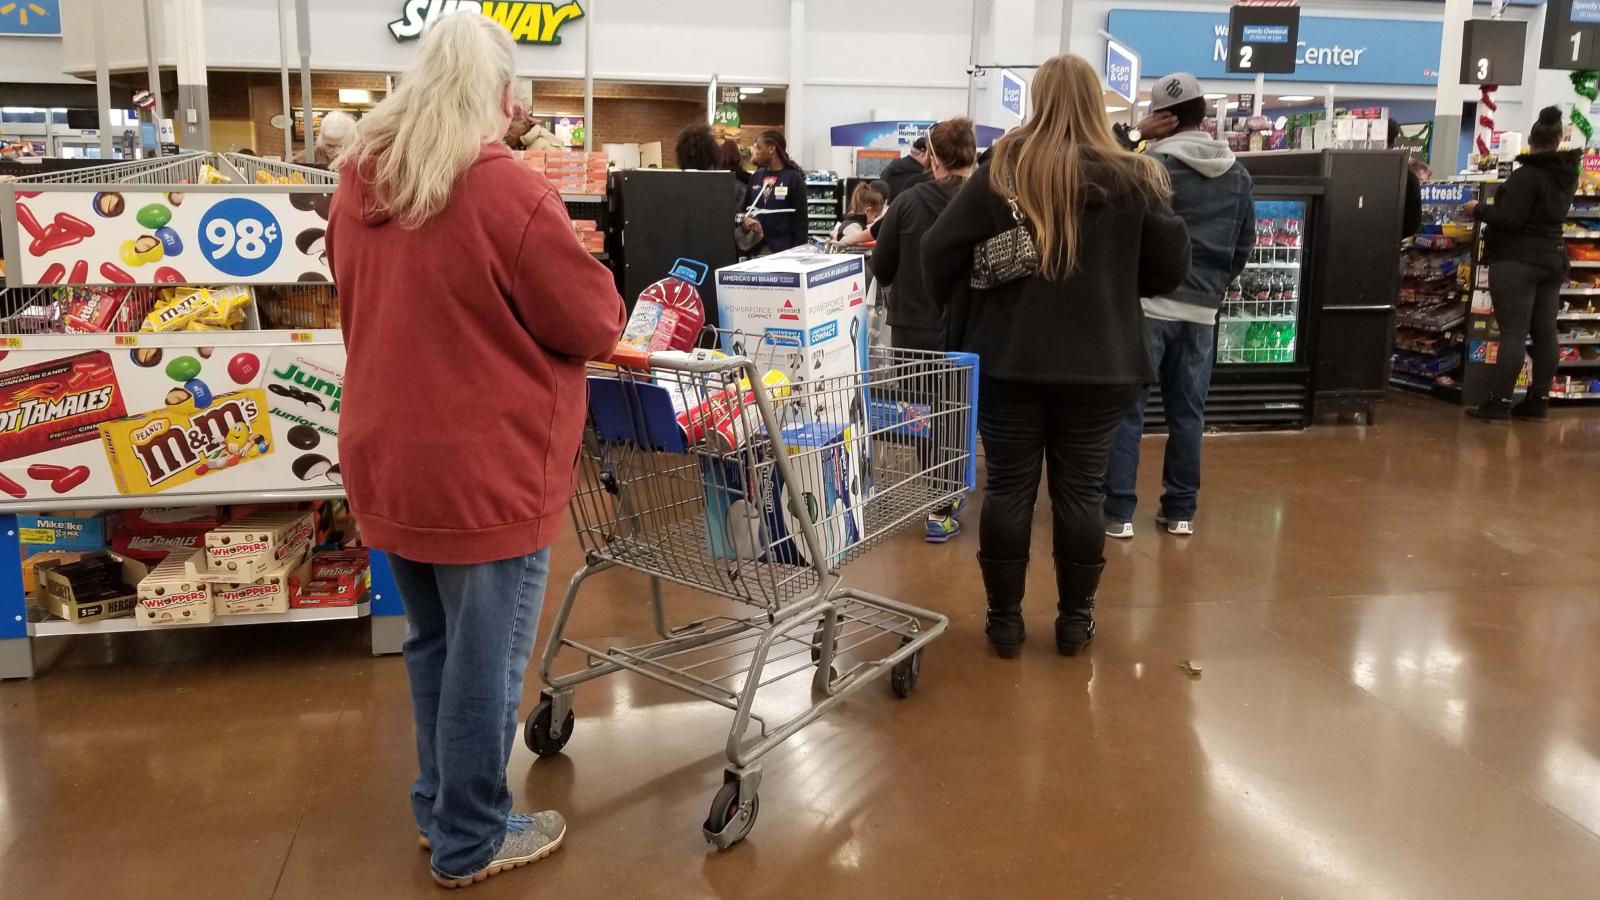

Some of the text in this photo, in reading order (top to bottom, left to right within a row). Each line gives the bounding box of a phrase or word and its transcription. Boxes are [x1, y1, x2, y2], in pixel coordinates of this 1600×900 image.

[387, 0, 584, 43] SWAY
[1571, 31, 1582, 62] 1
[1239, 45, 1253, 68] 2
[1110, 64, 1130, 74] Scan
[1477, 58, 1487, 80] 3
[1004, 87, 1020, 96] Scan
[1431, 187, 1463, 200] treats
[205, 218, 278, 260] 98¢
[722, 275, 751, 283] AMERICA'S
[758, 276, 778, 284] BRAND
[810, 270, 832, 284] AMERICA'S
[835, 265, 849, 276] BRAND
[725, 305, 772, 314] POWERFORCE
[808, 296, 845, 315] POWERFORCE
[825, 304, 845, 316] COMPACT
[811, 329, 836, 343] COMPACT
[0, 367, 69, 388] CINNAMON CANDY
[19, 385, 113, 431] TAMALES
[268, 407, 318, 427] Junior
[50, 422, 98, 440] FIERCE CINN
[136, 421, 163, 443] PEANUT
[37, 519, 84, 532] Mike Ike
[210, 542, 268, 558] WHOPPERS
[144, 591, 206, 608] WHOPPERS
[222, 584, 279, 601] WHOPPERS
